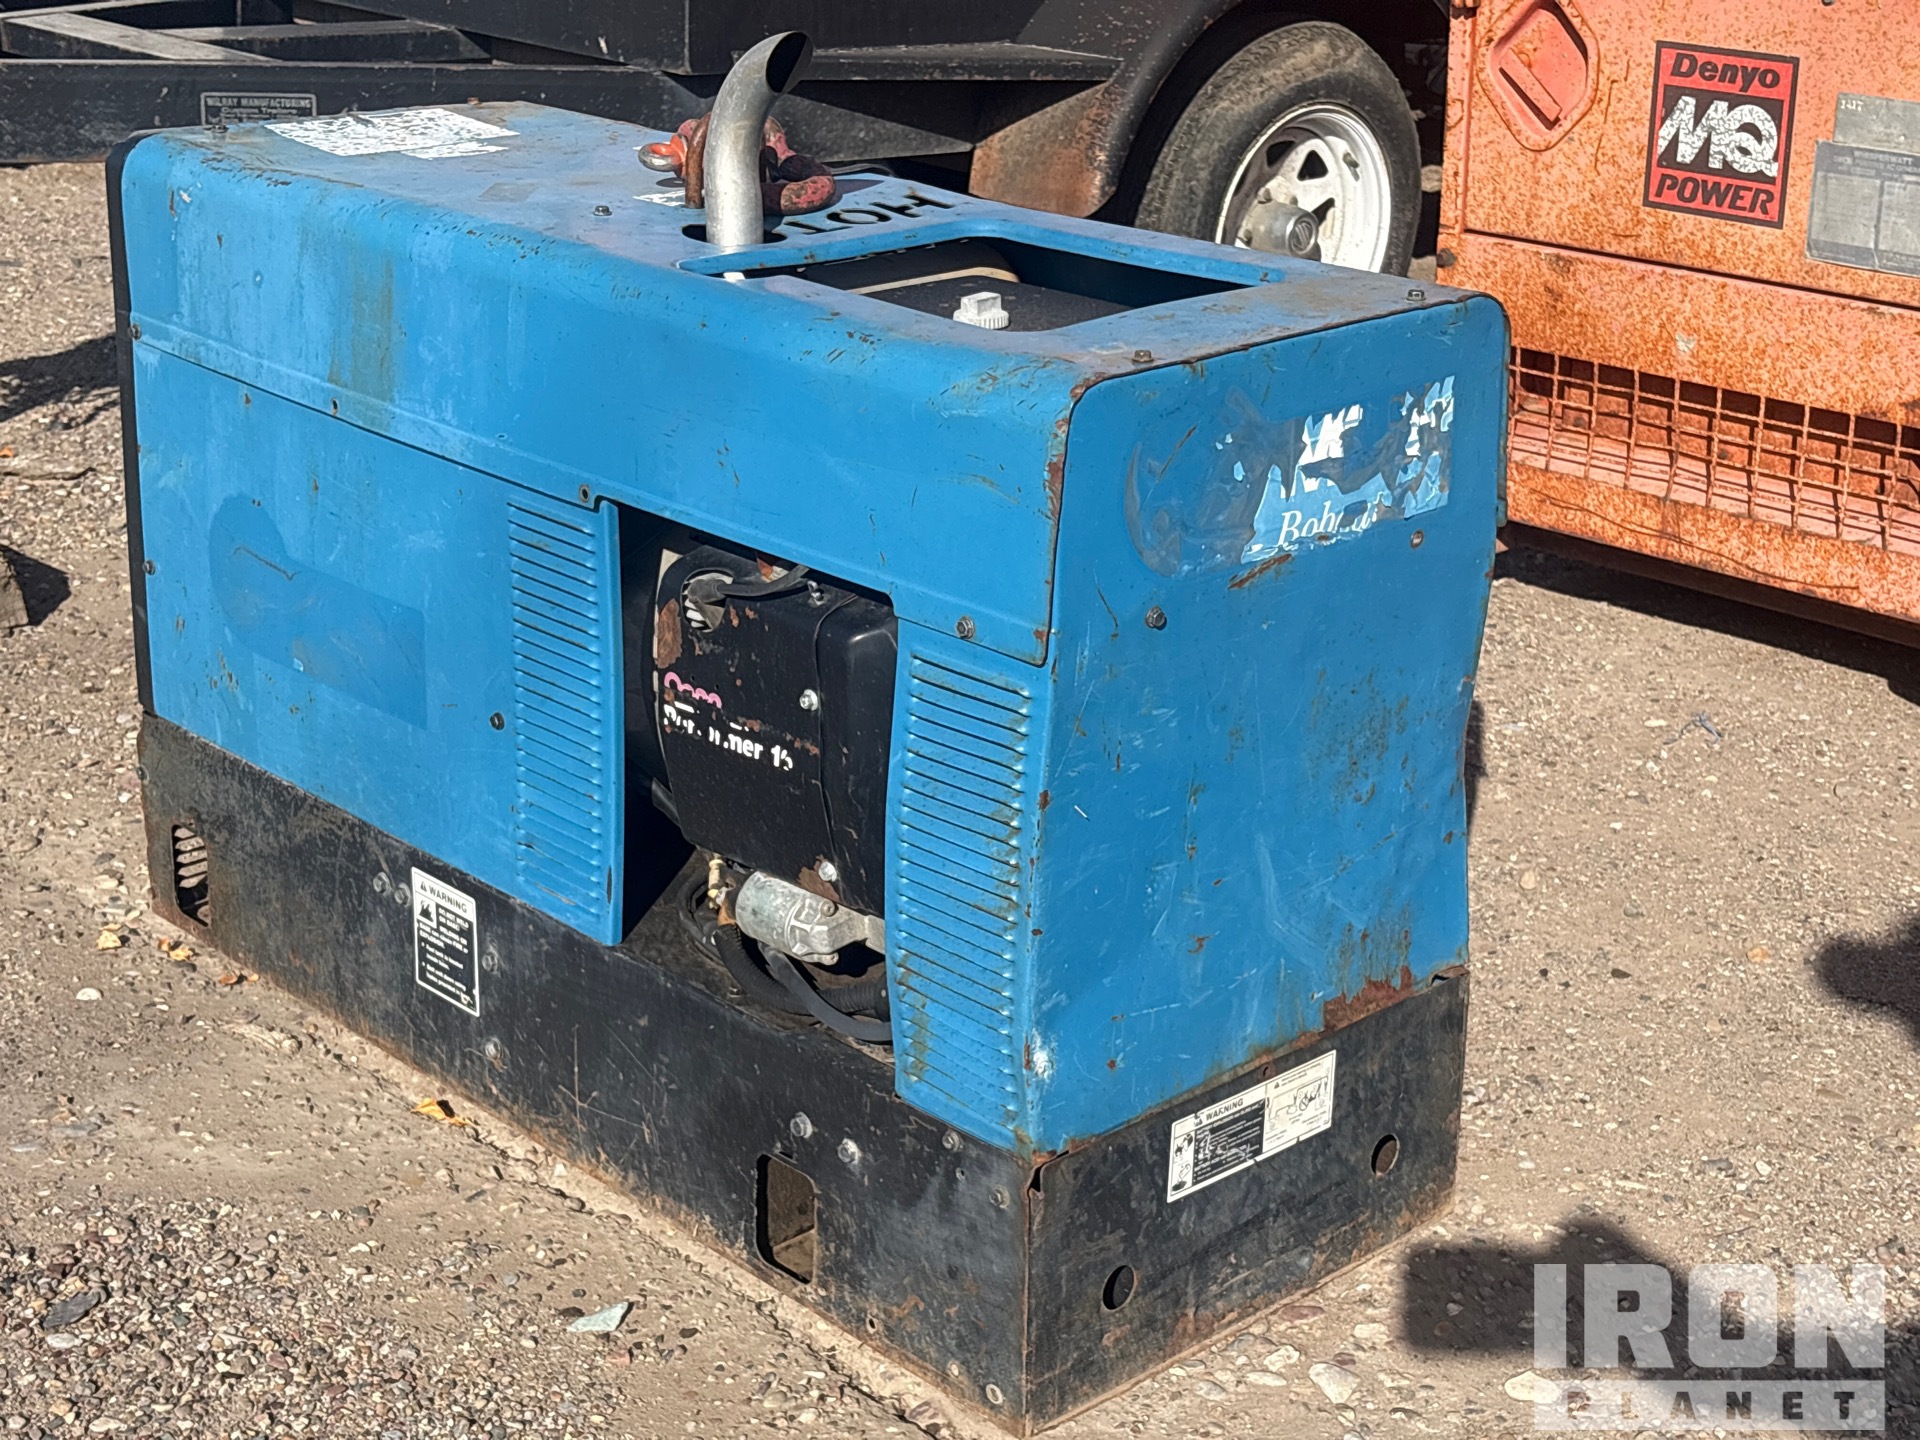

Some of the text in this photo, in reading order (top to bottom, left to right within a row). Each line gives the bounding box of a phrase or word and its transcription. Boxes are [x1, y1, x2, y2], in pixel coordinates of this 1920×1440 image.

[1670, 52, 1781, 93] Denyo
[241, 98, 311, 108] MANUFACTURING
[1657, 95, 1779, 177] MQ
[1654, 172, 1775, 215] POWER
[428, 884, 468, 914] WARNING
